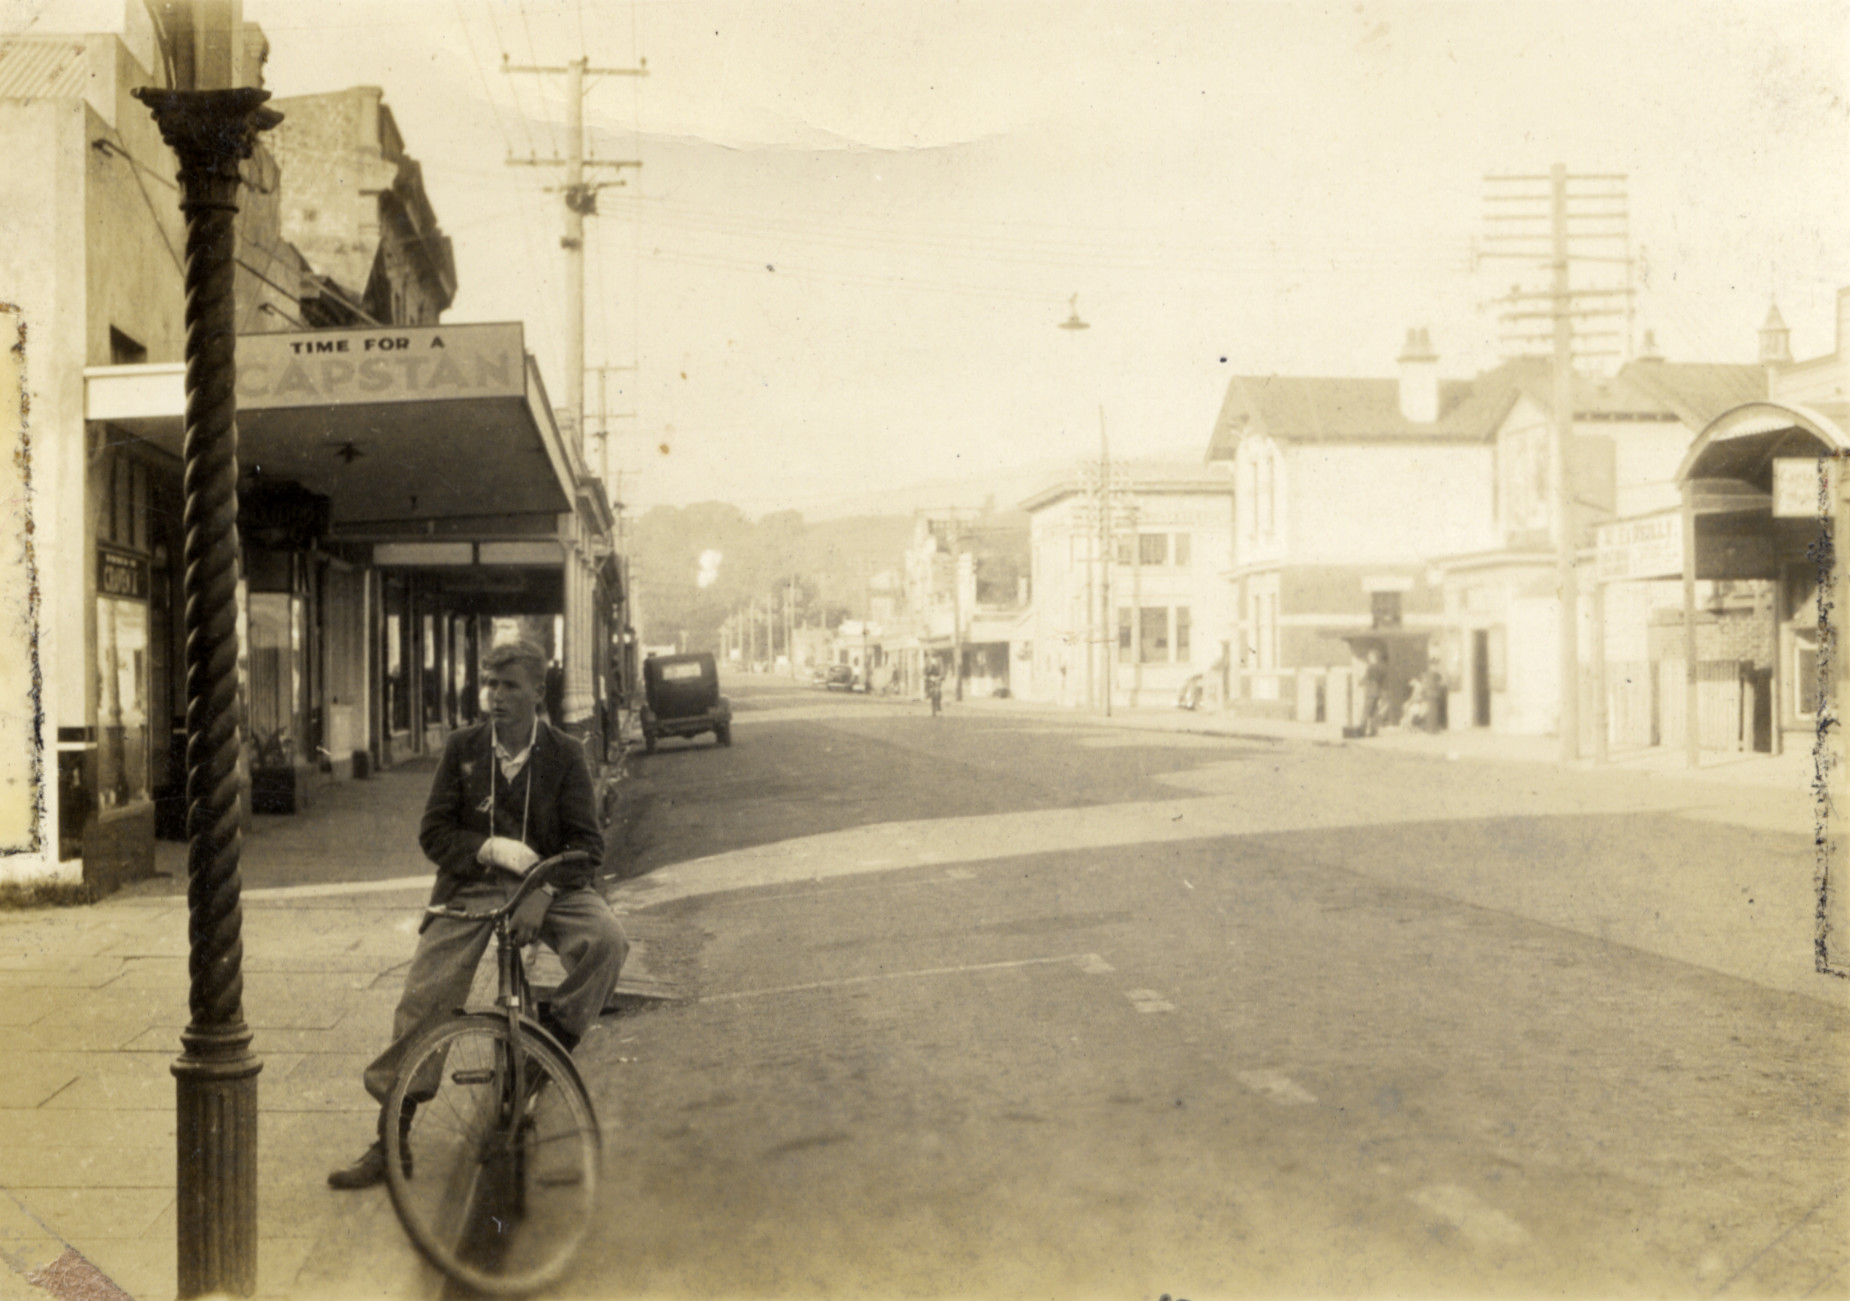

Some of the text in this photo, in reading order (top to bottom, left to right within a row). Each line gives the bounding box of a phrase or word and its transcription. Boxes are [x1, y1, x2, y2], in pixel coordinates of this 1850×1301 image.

[290, 335, 445, 354] TIME FOR A
[235, 351, 510, 398] CAPSTAN
